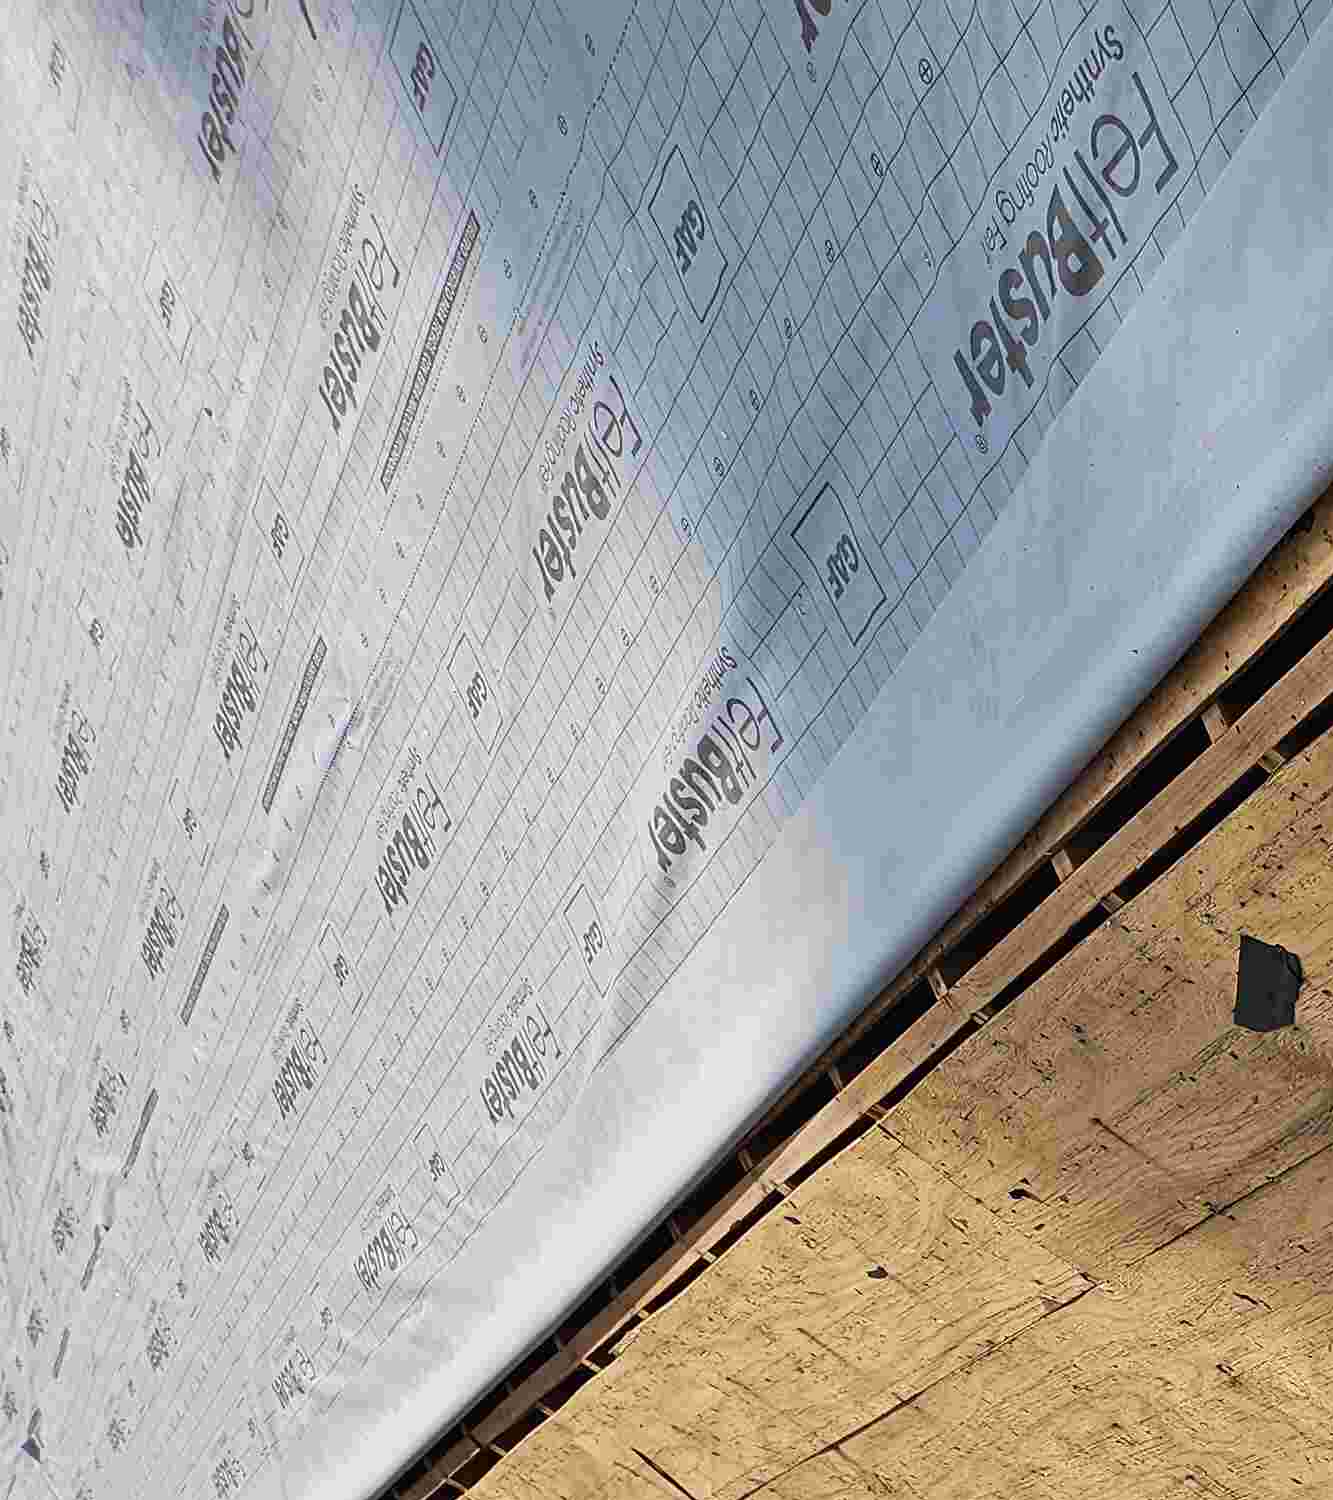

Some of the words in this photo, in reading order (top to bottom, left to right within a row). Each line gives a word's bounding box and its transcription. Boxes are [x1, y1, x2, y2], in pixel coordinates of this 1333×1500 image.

[410, 42, 435, 112] GAF
[1048, 24, 1125, 143] Synthetic
[995, 132, 1054, 228] Roofing
[672, 199, 707, 276] GAF
[827, 534, 859, 602] GAF
[466, 671, 488, 720] GAF
[583, 920, 606, 966] GAF
